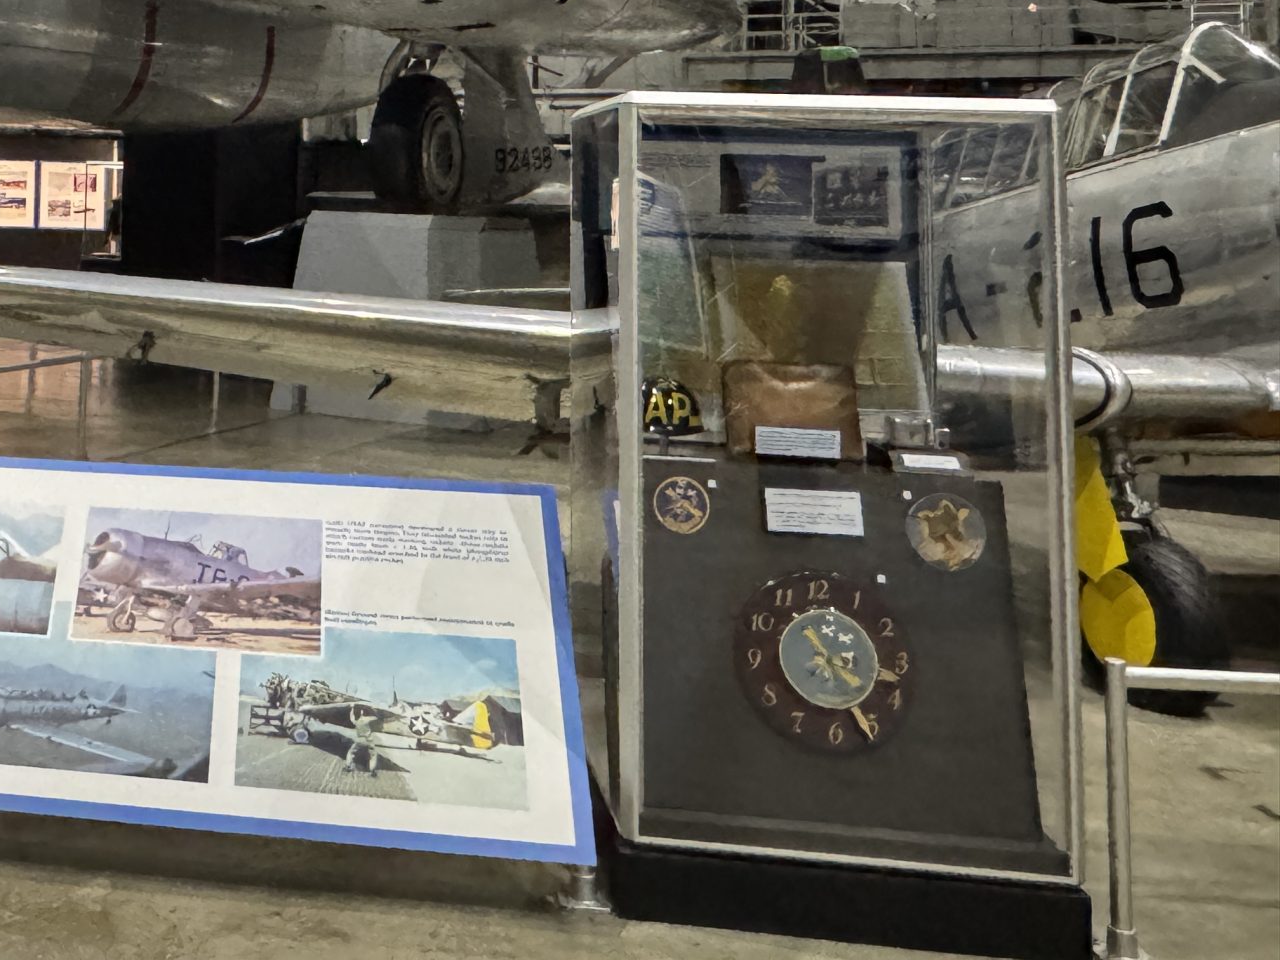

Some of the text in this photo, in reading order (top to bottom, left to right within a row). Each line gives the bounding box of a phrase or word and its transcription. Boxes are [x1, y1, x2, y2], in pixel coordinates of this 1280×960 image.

[774, 588, 793, 607] 11
[807, 579, 830, 600] 12
[751, 612, 775, 631] 10
[878, 617, 895, 638] 2
[747, 648, 762, 670] 9
[895, 651, 909, 675] 3
[790, 711, 806, 734] 7
[828, 721, 844, 745] 6
